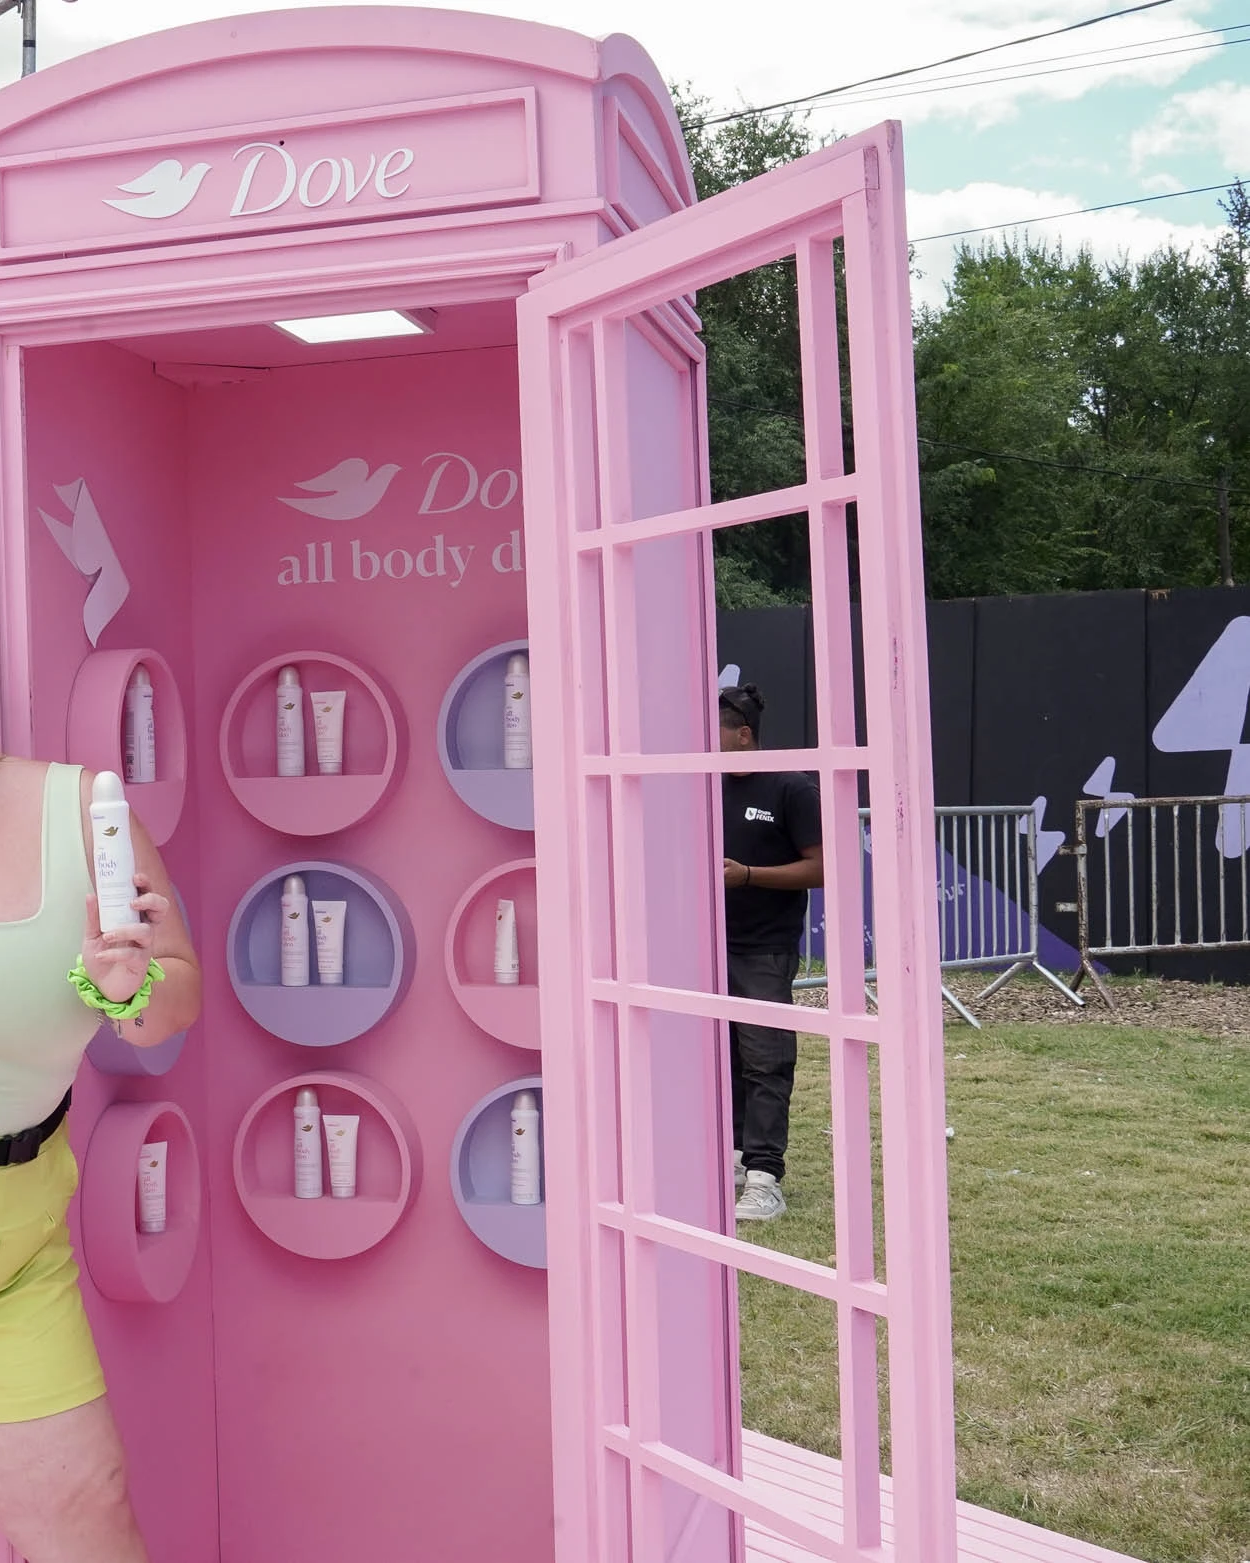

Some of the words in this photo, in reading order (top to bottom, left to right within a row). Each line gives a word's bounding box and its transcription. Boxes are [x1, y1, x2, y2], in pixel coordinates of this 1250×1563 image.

[229, 142, 415, 217] Dove
[417, 452, 519, 514] Do
[277, 541, 336, 586] all
[349, 533, 476, 588] body
